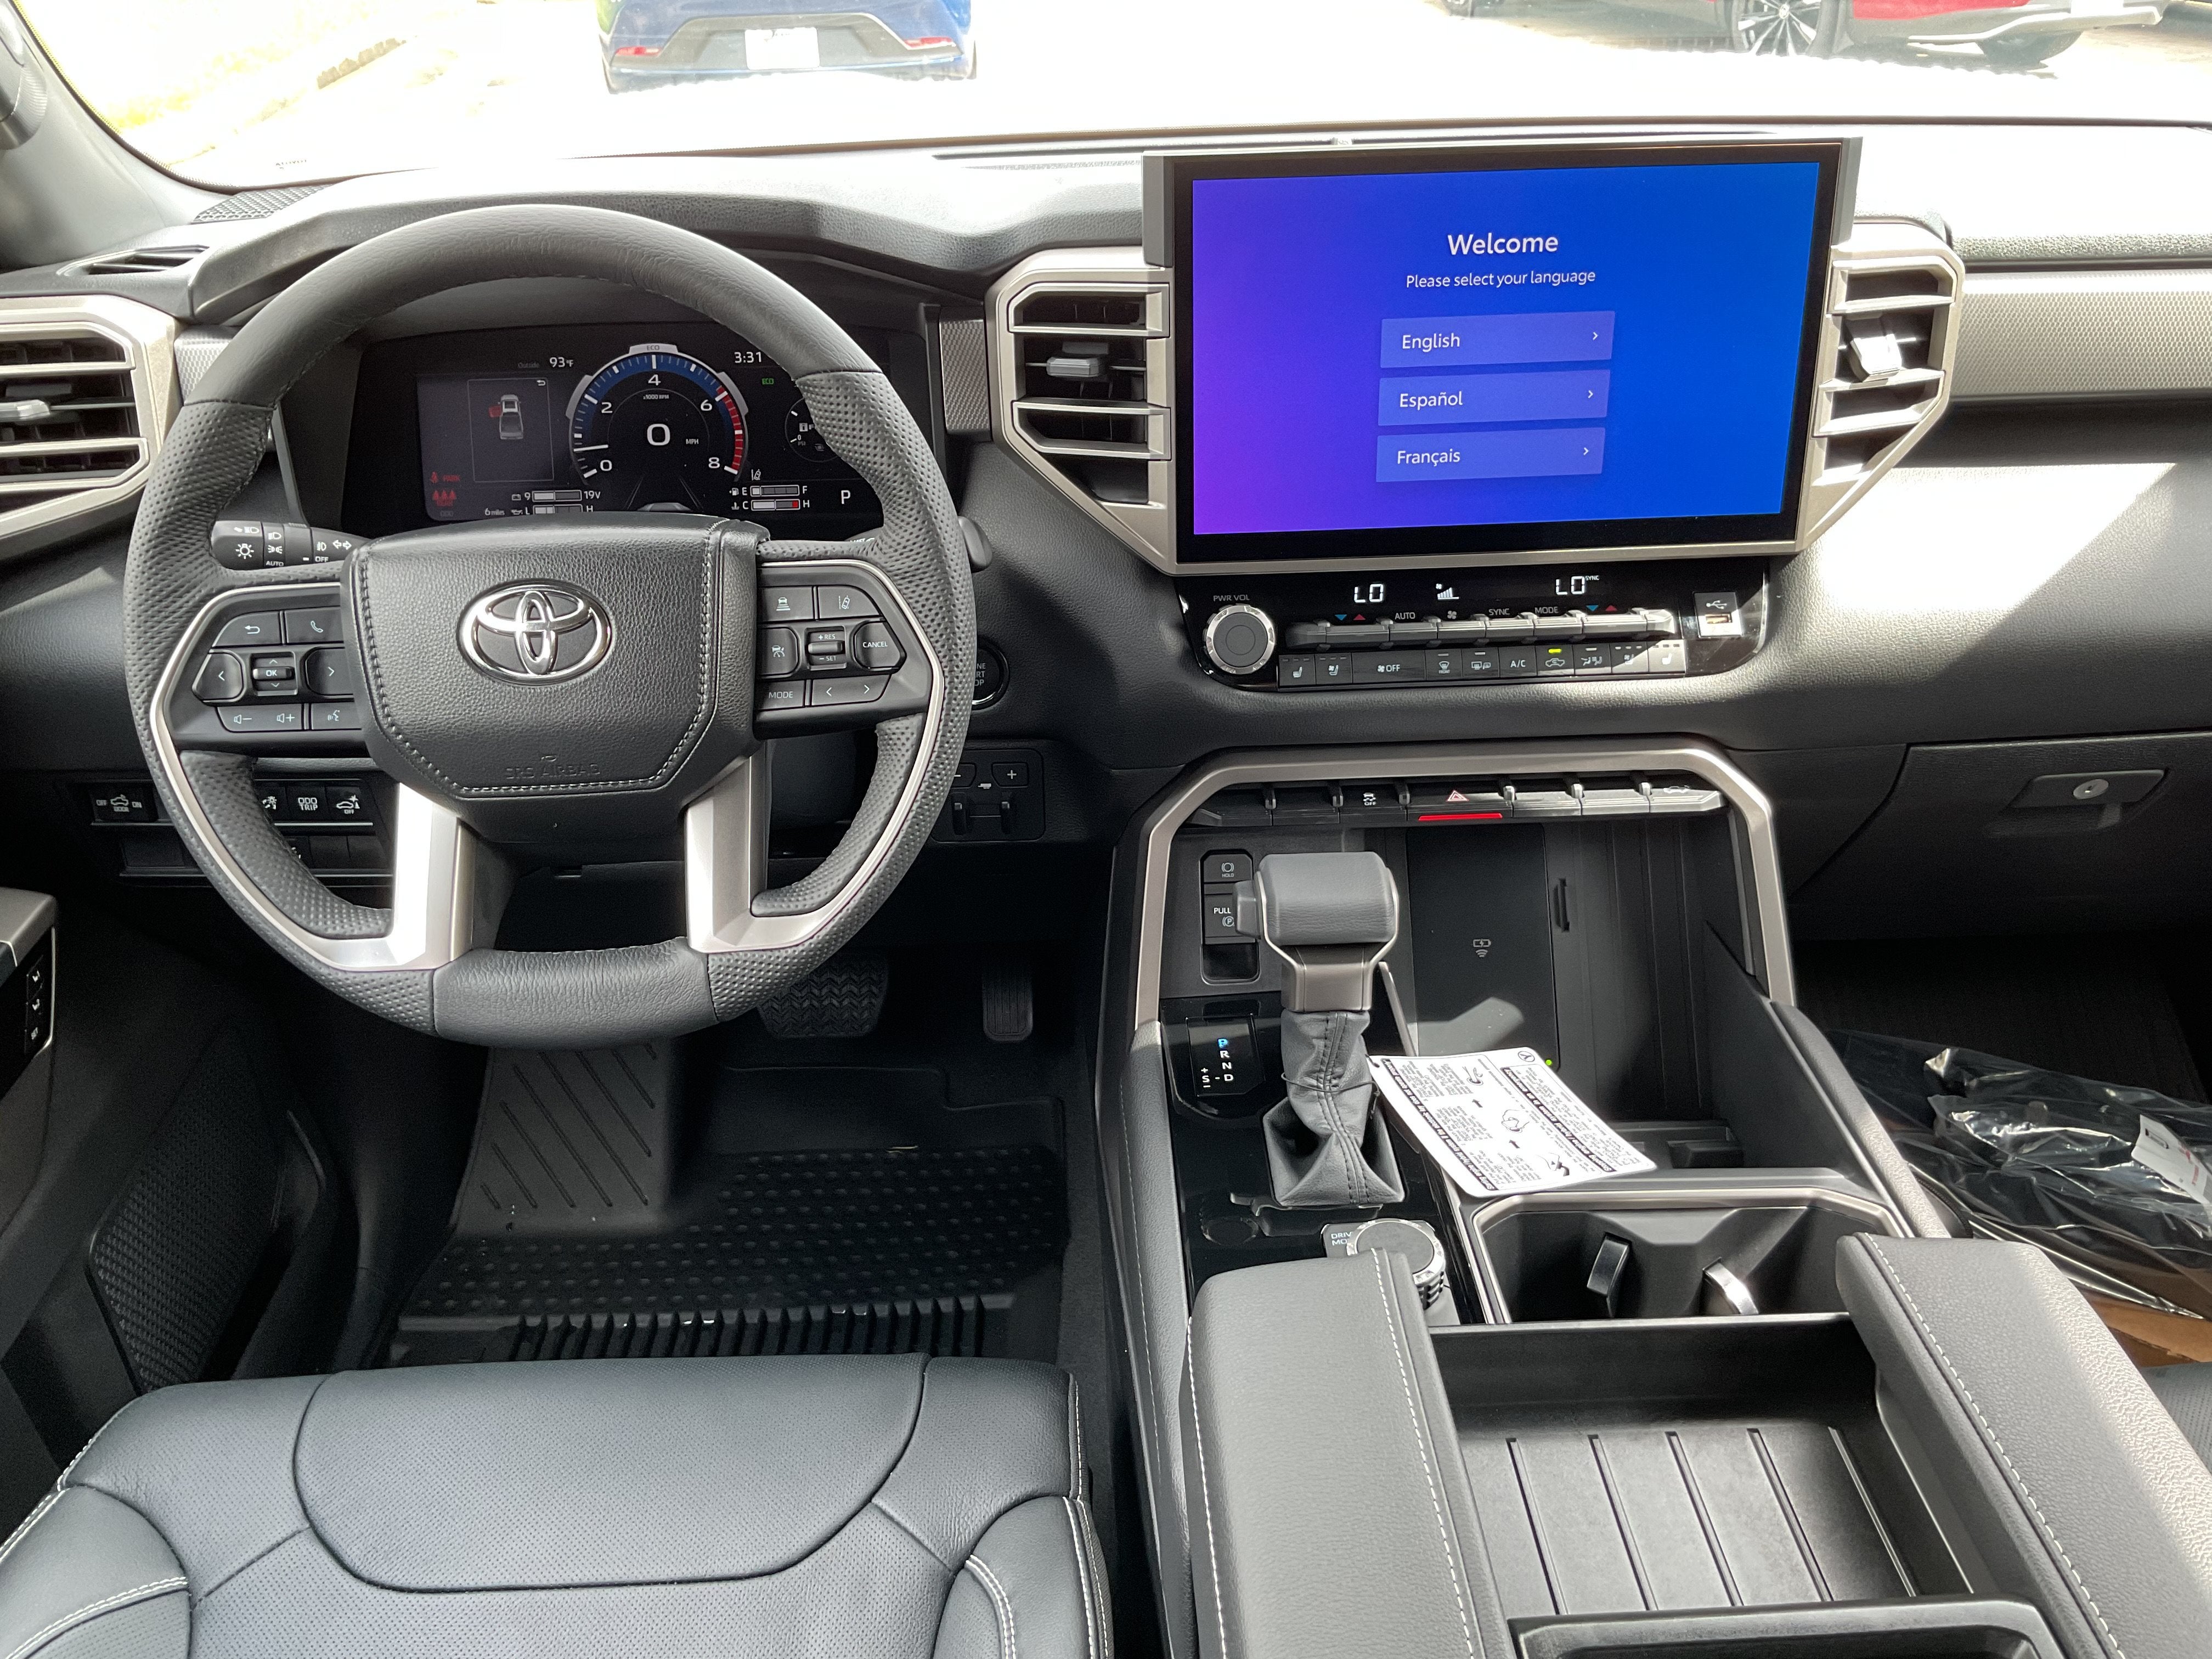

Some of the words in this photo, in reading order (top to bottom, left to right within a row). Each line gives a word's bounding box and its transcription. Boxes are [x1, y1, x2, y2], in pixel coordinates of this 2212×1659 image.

[1447, 233, 1559, 255] Welcome
[1406, 275, 1450, 288] Please
[1454, 273, 1493, 286] select
[1497, 273, 1527, 288] your
[1531, 270, 1595, 286] language
[1402, 333, 1460, 352] English
[734, 351, 762, 363] 3:31
[648, 374, 661, 386] 4
[701, 399, 712, 411] 6
[1400, 391, 1463, 410] Español
[601, 402, 613, 414] 2
[646, 424, 670, 446] 0
[708, 458, 720, 469] 8
[1397, 449, 1460, 466] Français
[600, 460, 612, 471] 0
[524, 492, 531, 500] 9
[584, 490, 601, 499] 19V
[841, 490, 850, 504] P
[743, 501, 748, 509] C
[1395, 612, 1415, 620] AUTO
[1534, 606, 1559, 614] MODE
[1386, 664, 1401, 673] OFF
[1510, 659, 1526, 668] A/C
[1218, 1039, 1228, 1047] P
[1220, 1050, 1230, 1058] R
[1503, 1069, 1531, 1092] emergency
[1537, 1105, 1559, 1121] system
[1553, 1122, 1574, 1137] hybrid
[1569, 1139, 1592, 1154] engine
[1587, 1154, 1612, 1171] Stopping
